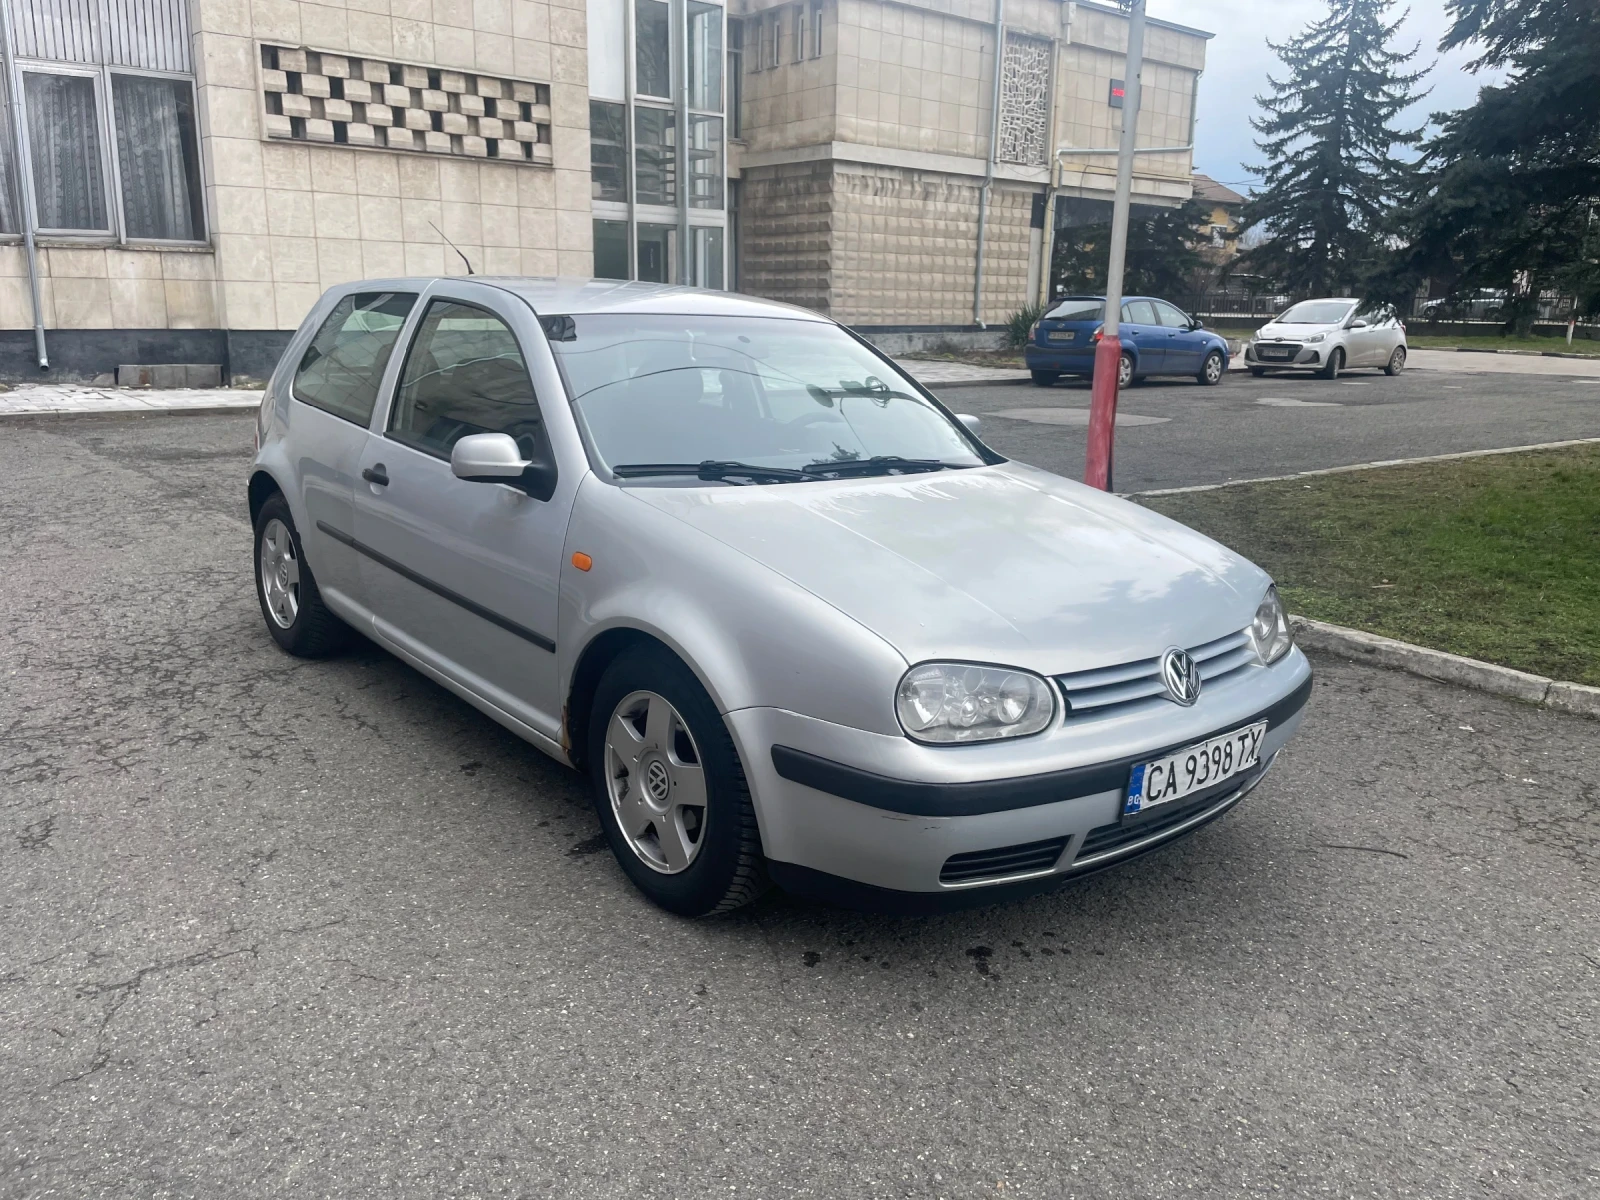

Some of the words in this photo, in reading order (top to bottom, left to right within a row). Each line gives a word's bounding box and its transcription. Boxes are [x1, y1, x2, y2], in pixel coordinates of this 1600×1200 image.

[1147, 761, 1177, 801] CA
[1186, 741, 1233, 790] 9398
[1237, 729, 1262, 767] TX
[1127, 794, 1140, 805] BG
